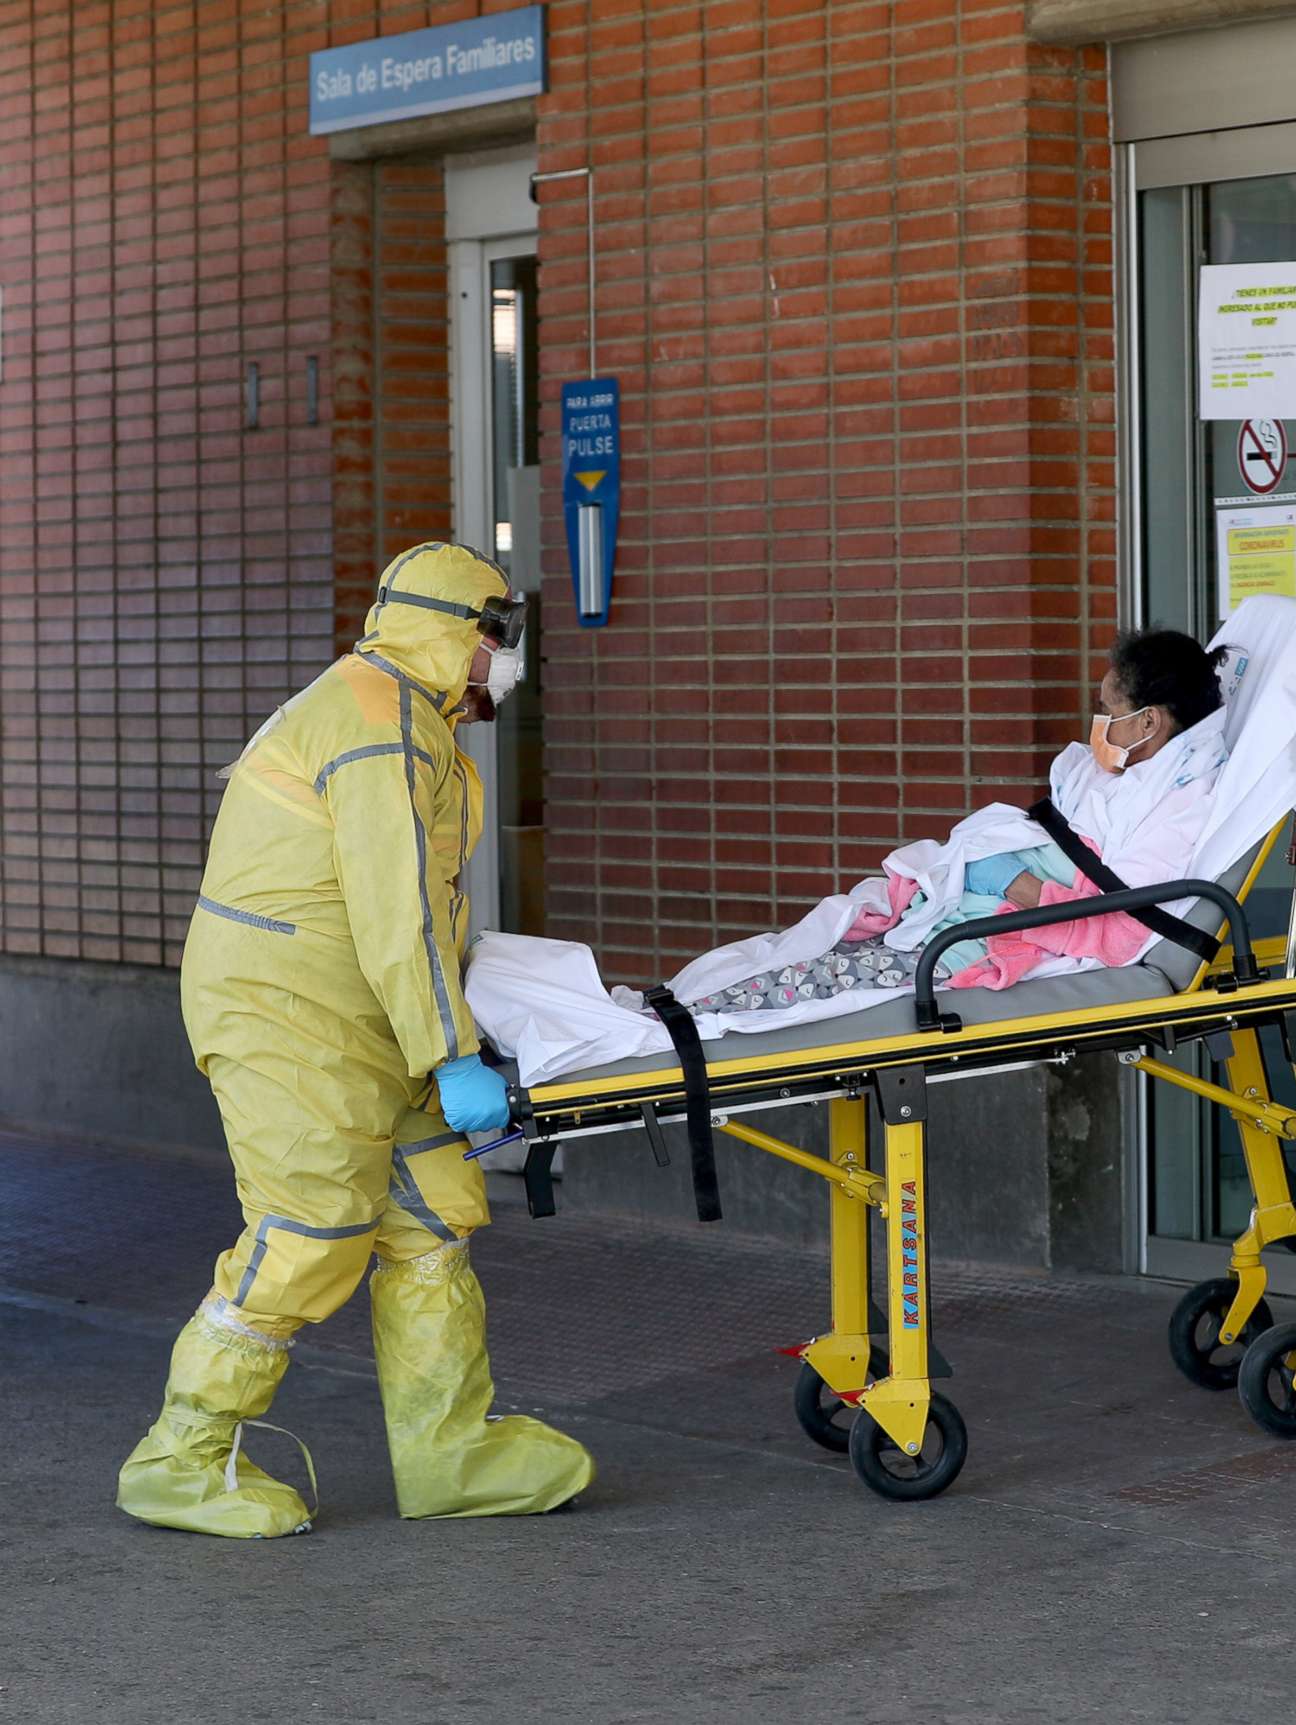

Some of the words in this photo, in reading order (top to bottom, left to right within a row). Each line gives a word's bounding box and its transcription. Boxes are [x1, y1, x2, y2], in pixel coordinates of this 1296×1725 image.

[317, 68, 351, 101] Sala
[356, 63, 376, 93] de
[382, 55, 441, 92] Espera
[447, 36, 535, 76] Familiares
[567, 396, 588, 409] PARA
[589, 393, 614, 407] ABRIR
[569, 413, 612, 432] PUERTA
[567, 435, 614, 457] PULSE
[901, 1181, 919, 1325] KARTSANA
